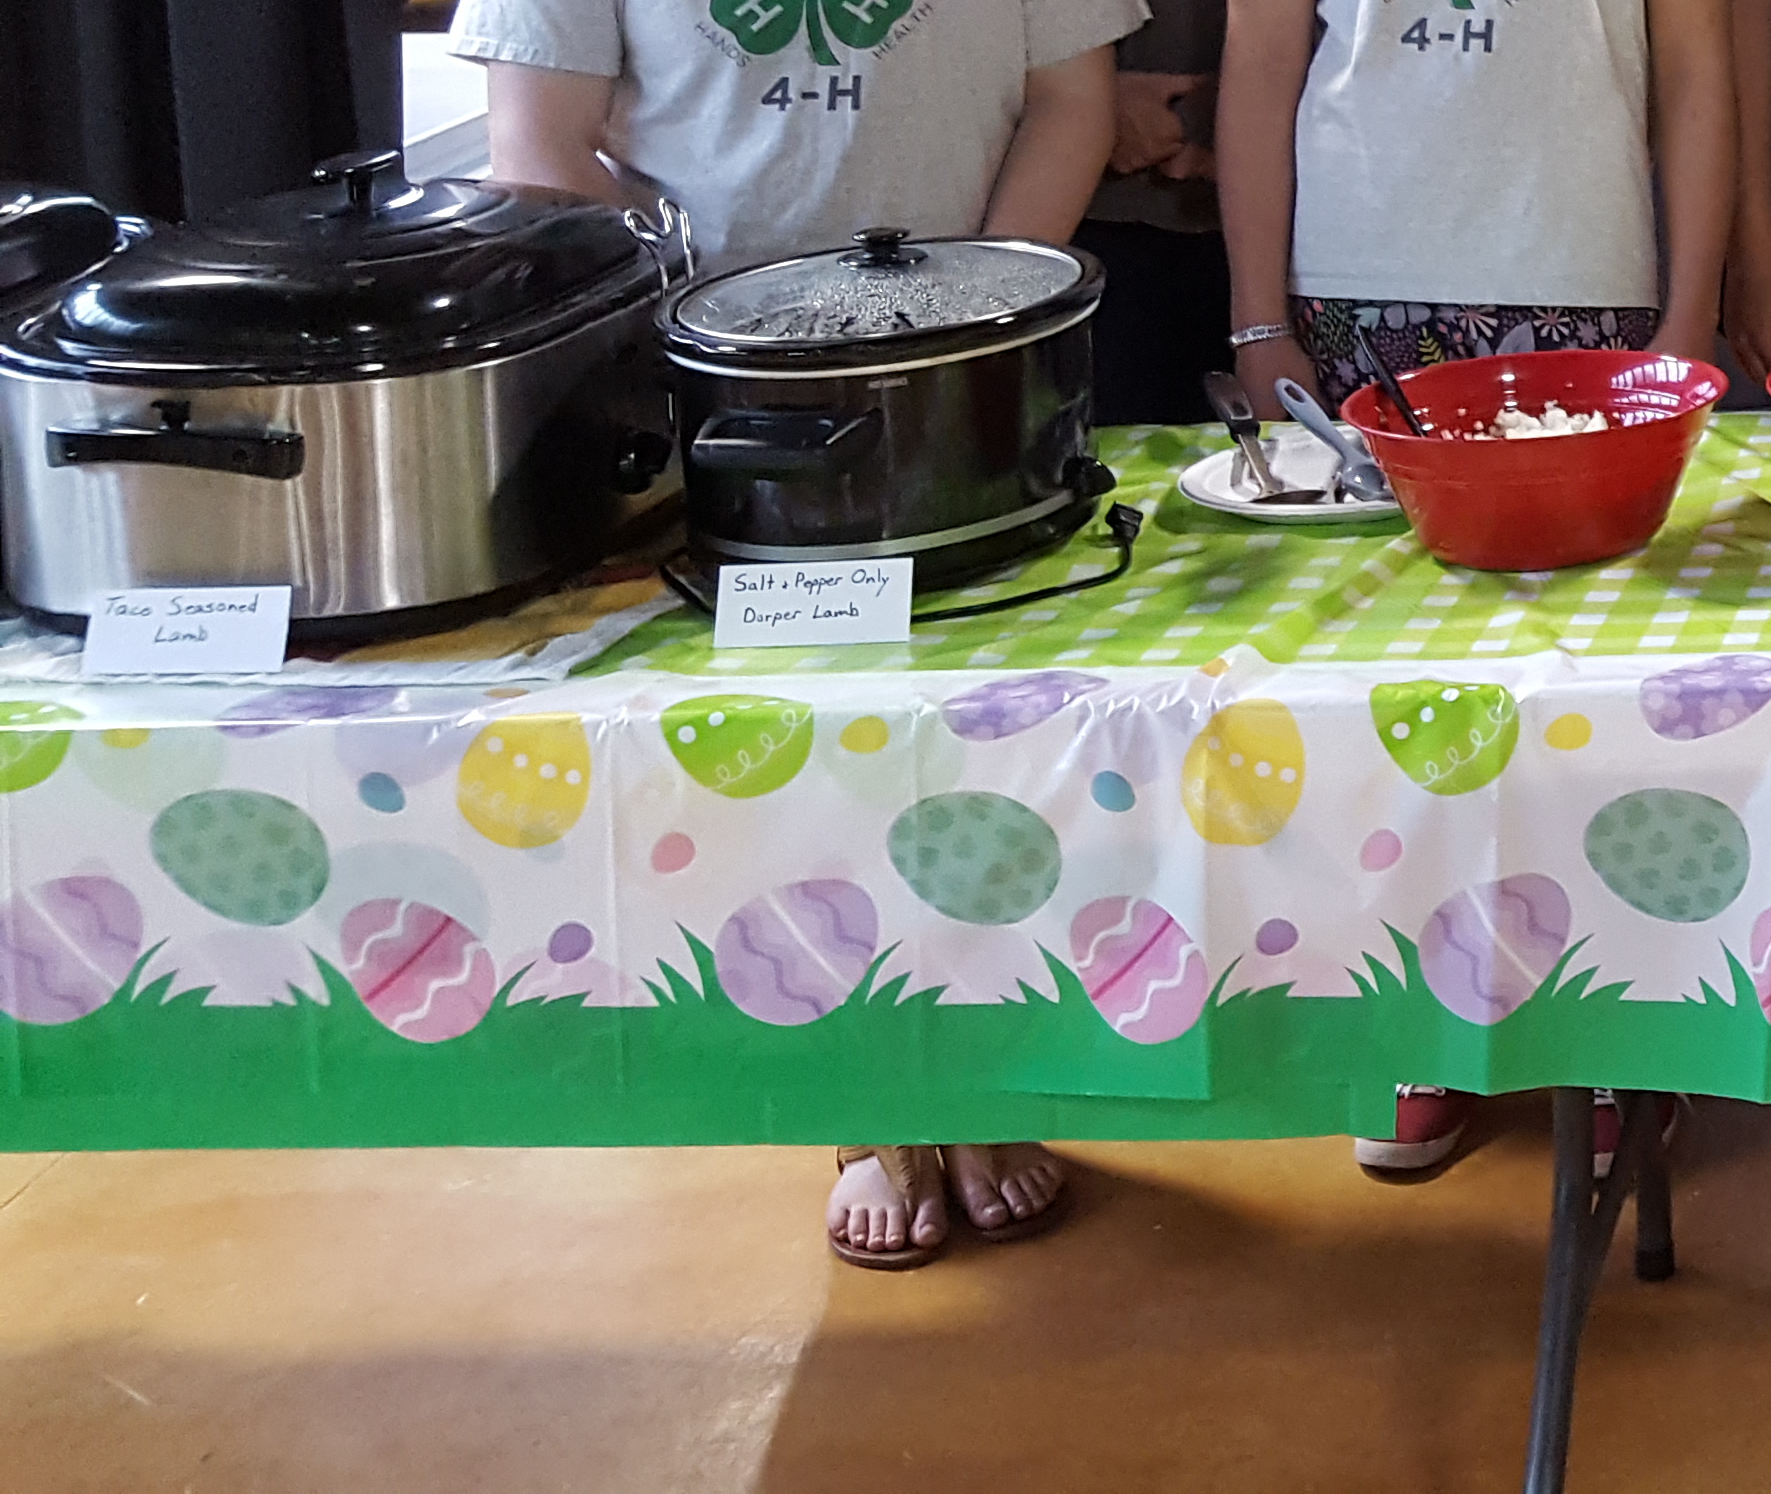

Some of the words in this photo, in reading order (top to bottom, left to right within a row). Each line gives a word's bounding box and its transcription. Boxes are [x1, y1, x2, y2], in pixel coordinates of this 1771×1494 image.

[694, 23, 750, 68] HANDS
[872, 2, 935, 60] HEALTH
[1401, 17, 1495, 53] 4-H
[761, 75, 862, 111] 4-H
[734, 573, 775, 593] Salt
[795, 571, 844, 596] Pepper
[851, 567, 890, 598] Only
[105, 595, 152, 616] Taco
[167, 593, 259, 616] Seasoned
[812, 601, 860, 619] Lamb
[153, 624, 208, 643] Lamb
